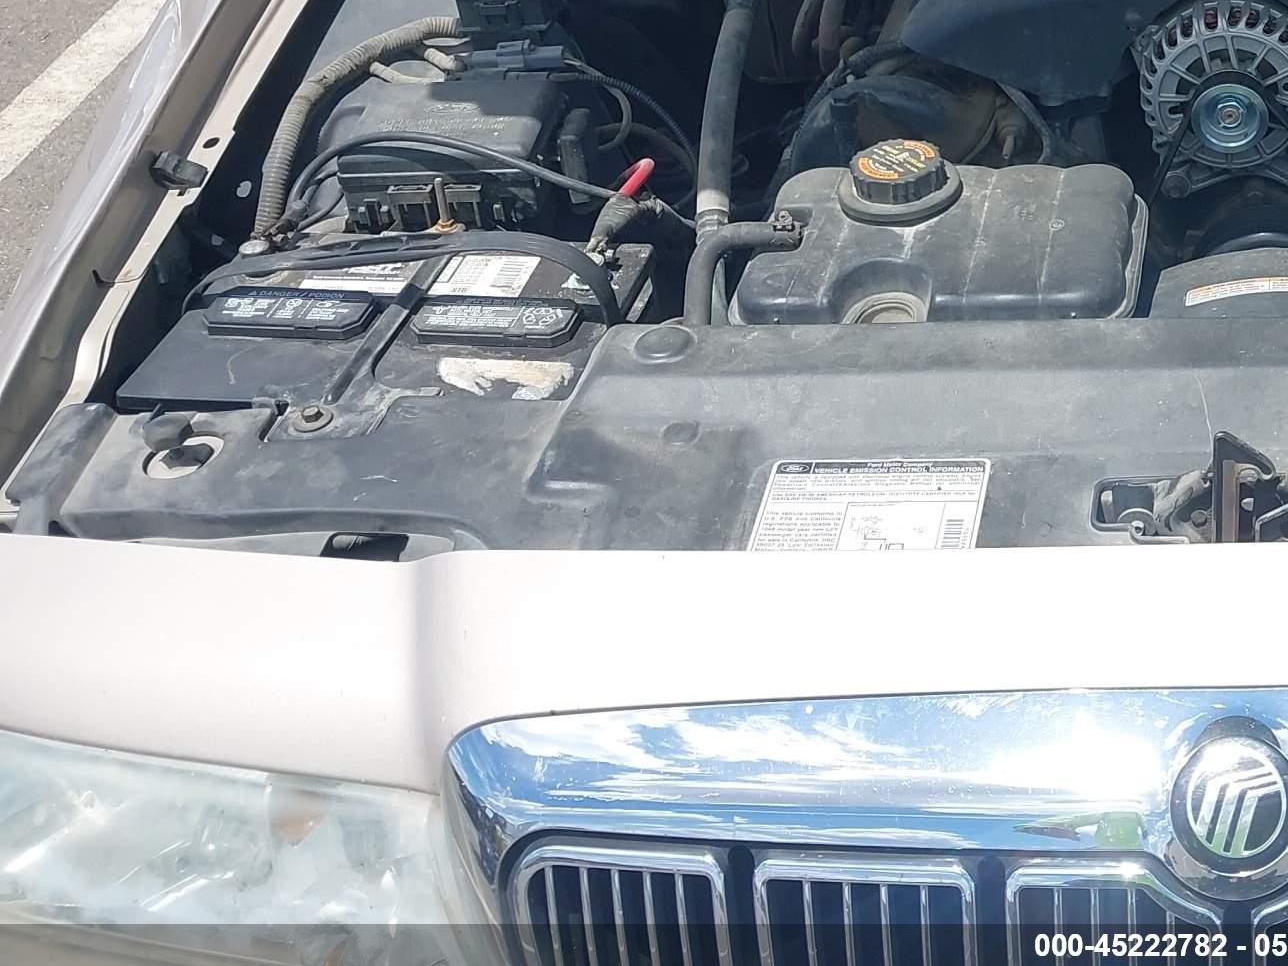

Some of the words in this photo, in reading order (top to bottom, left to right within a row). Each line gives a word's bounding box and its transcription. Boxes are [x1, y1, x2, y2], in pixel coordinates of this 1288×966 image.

[259, 290, 299, 298] DANGER
[308, 292, 345, 300] POISON
[849, 466, 888, 474] EMISSION
[929, 465, 985, 473] INFORMATION
